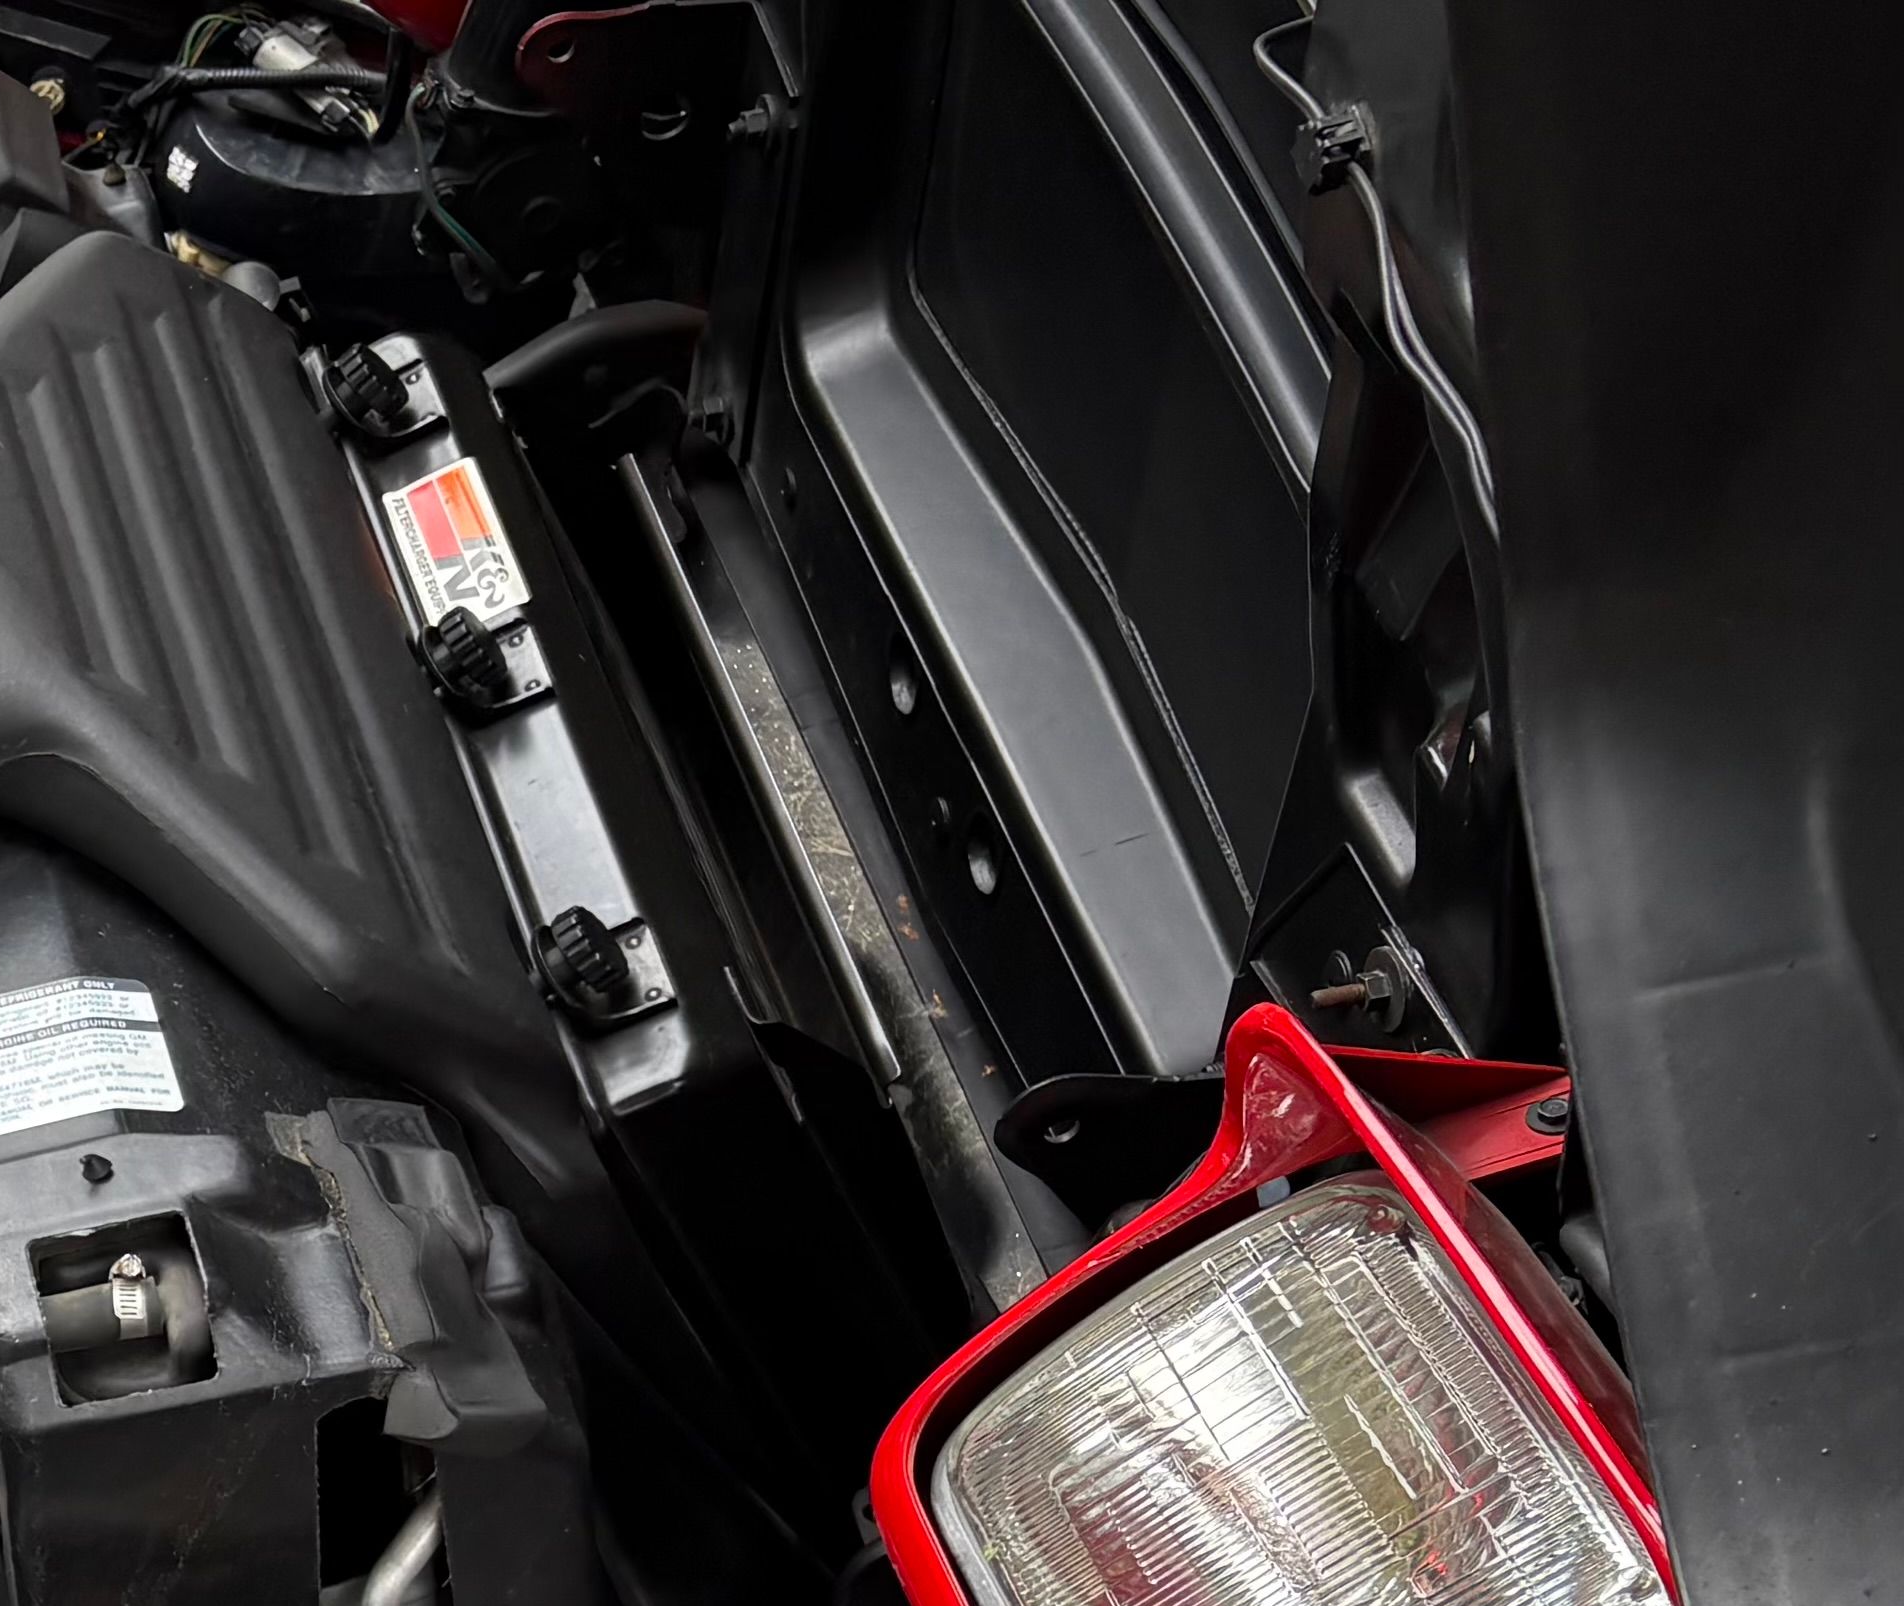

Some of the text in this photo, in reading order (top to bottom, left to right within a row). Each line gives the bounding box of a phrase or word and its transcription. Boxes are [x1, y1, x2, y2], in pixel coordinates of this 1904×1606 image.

[82, 979, 116, 990] ONLY
[37, 1026, 59, 1038] OIL
[62, 1019, 127, 1033] REQUIRED
